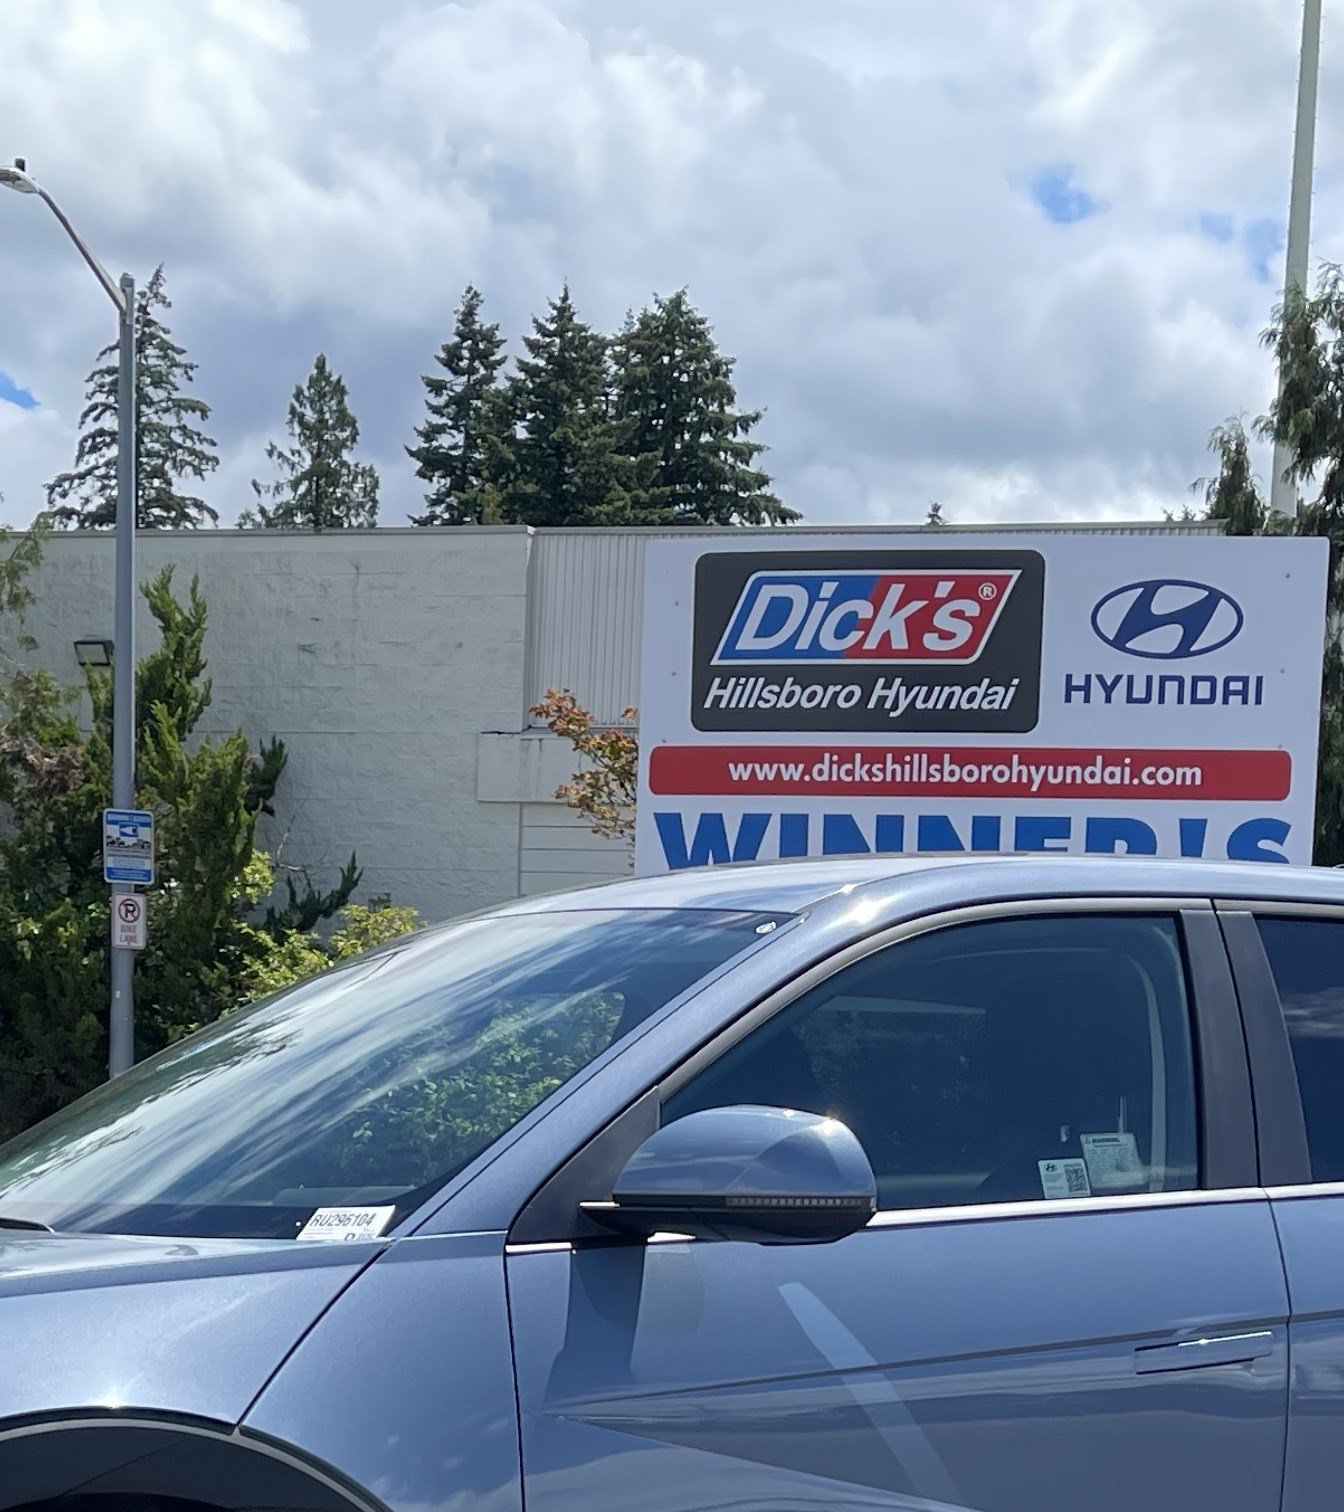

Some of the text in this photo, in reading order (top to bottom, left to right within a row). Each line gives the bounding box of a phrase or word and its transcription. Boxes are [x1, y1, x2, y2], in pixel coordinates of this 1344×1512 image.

[704, 677, 1020, 717] Hillsboro Hyundai
[1064, 674, 1263, 705] HYUNDAI
[728, 753, 1202, 792] www.dickshillsborohyundai.com
